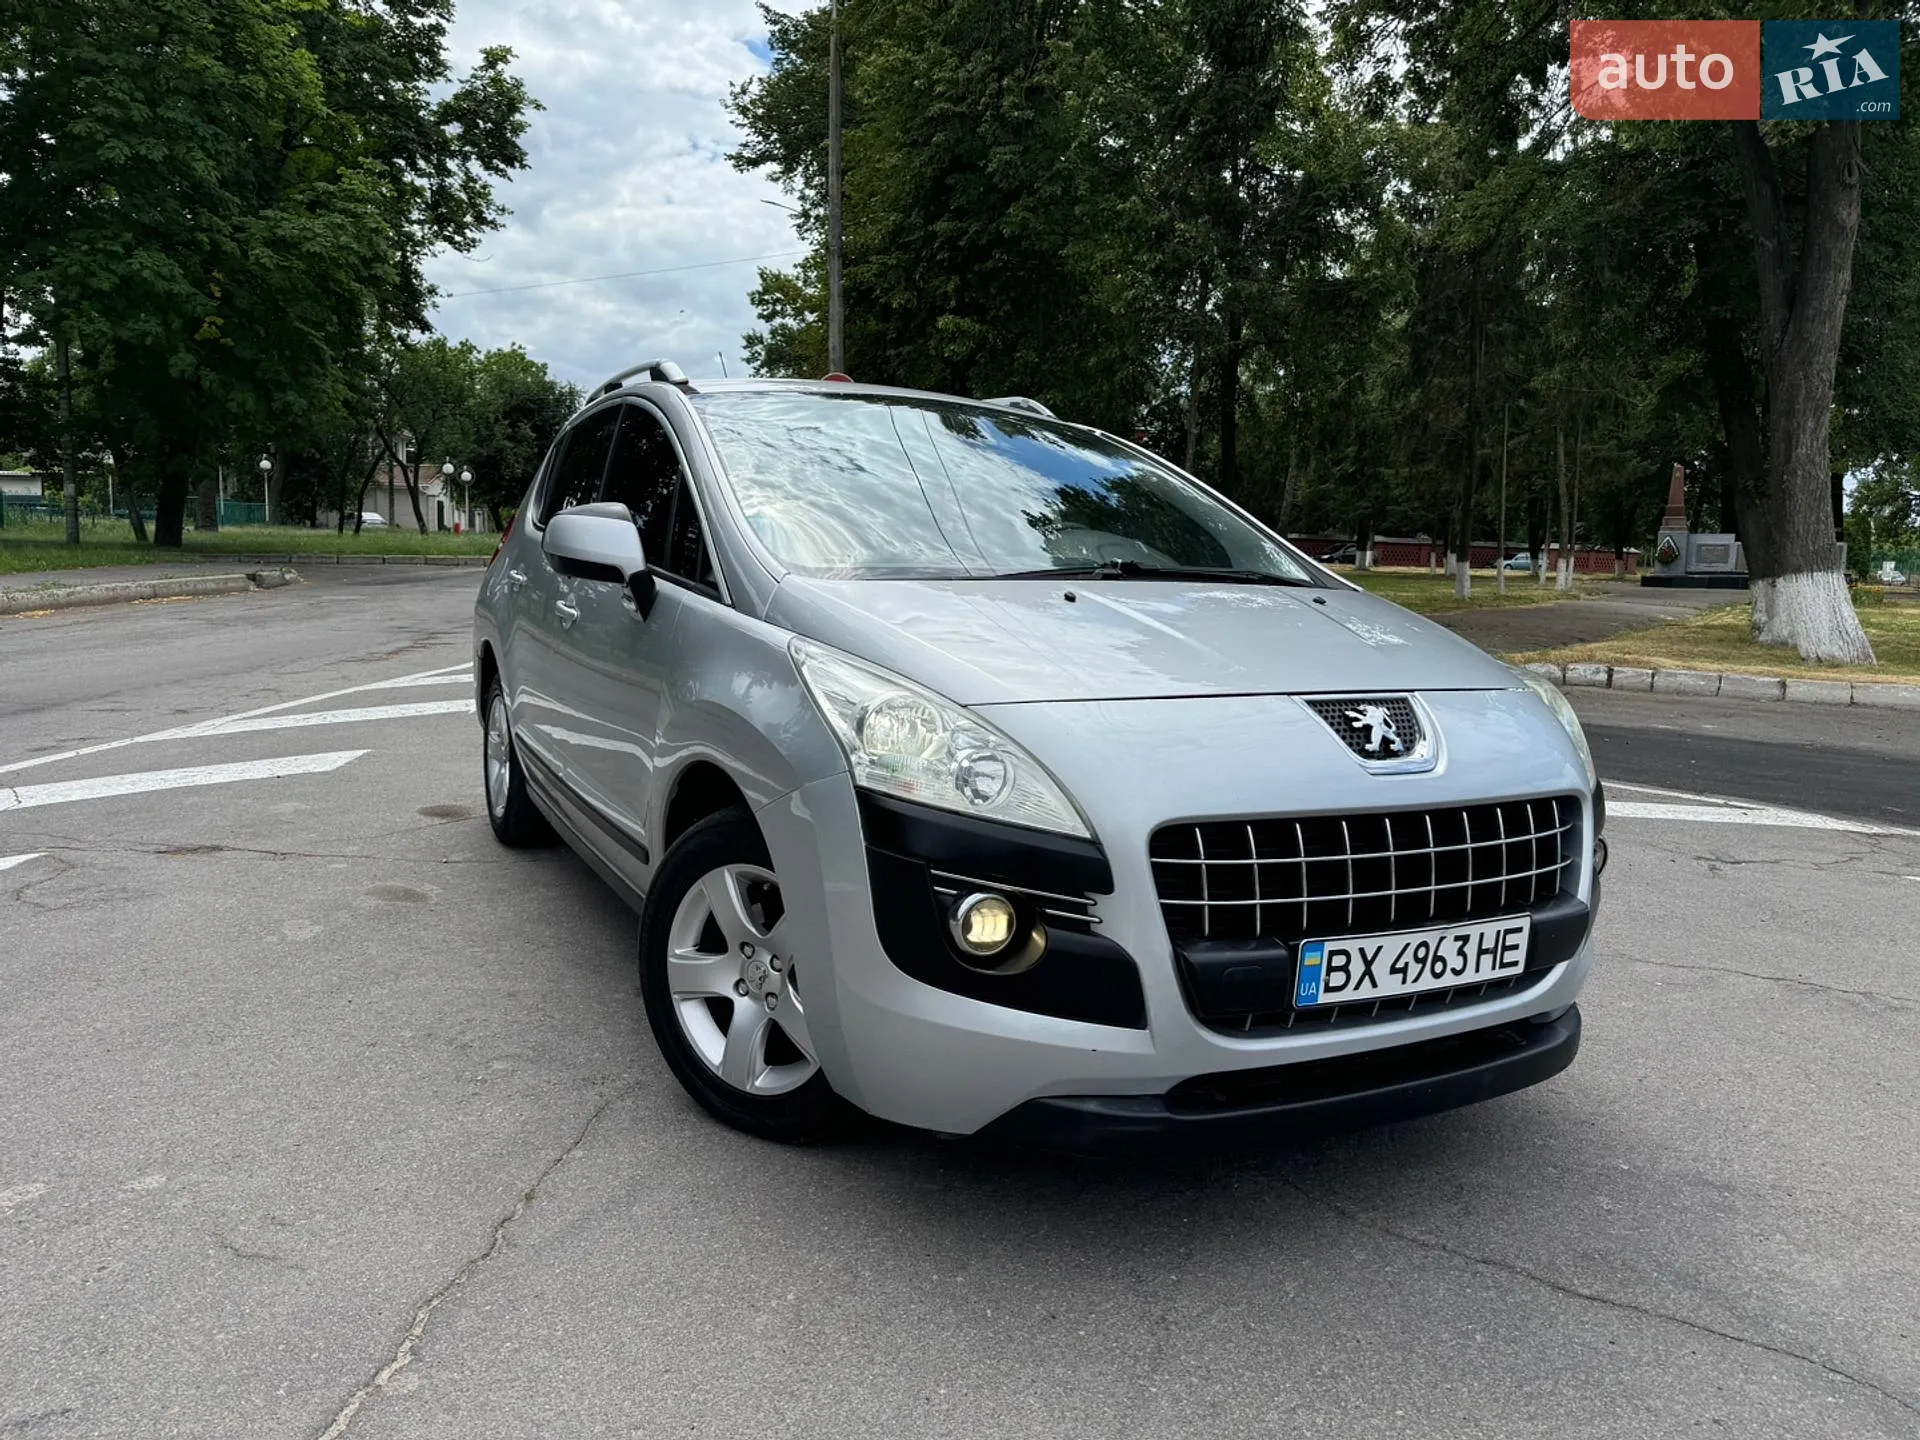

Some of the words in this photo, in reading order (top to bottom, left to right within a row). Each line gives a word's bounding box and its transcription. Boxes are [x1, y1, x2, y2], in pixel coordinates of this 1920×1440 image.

[1323, 945, 1384, 994] BX
[1389, 934, 1472, 985] 4963
[1475, 926, 1524, 974] HE
[1299, 981, 1318, 997] UA
